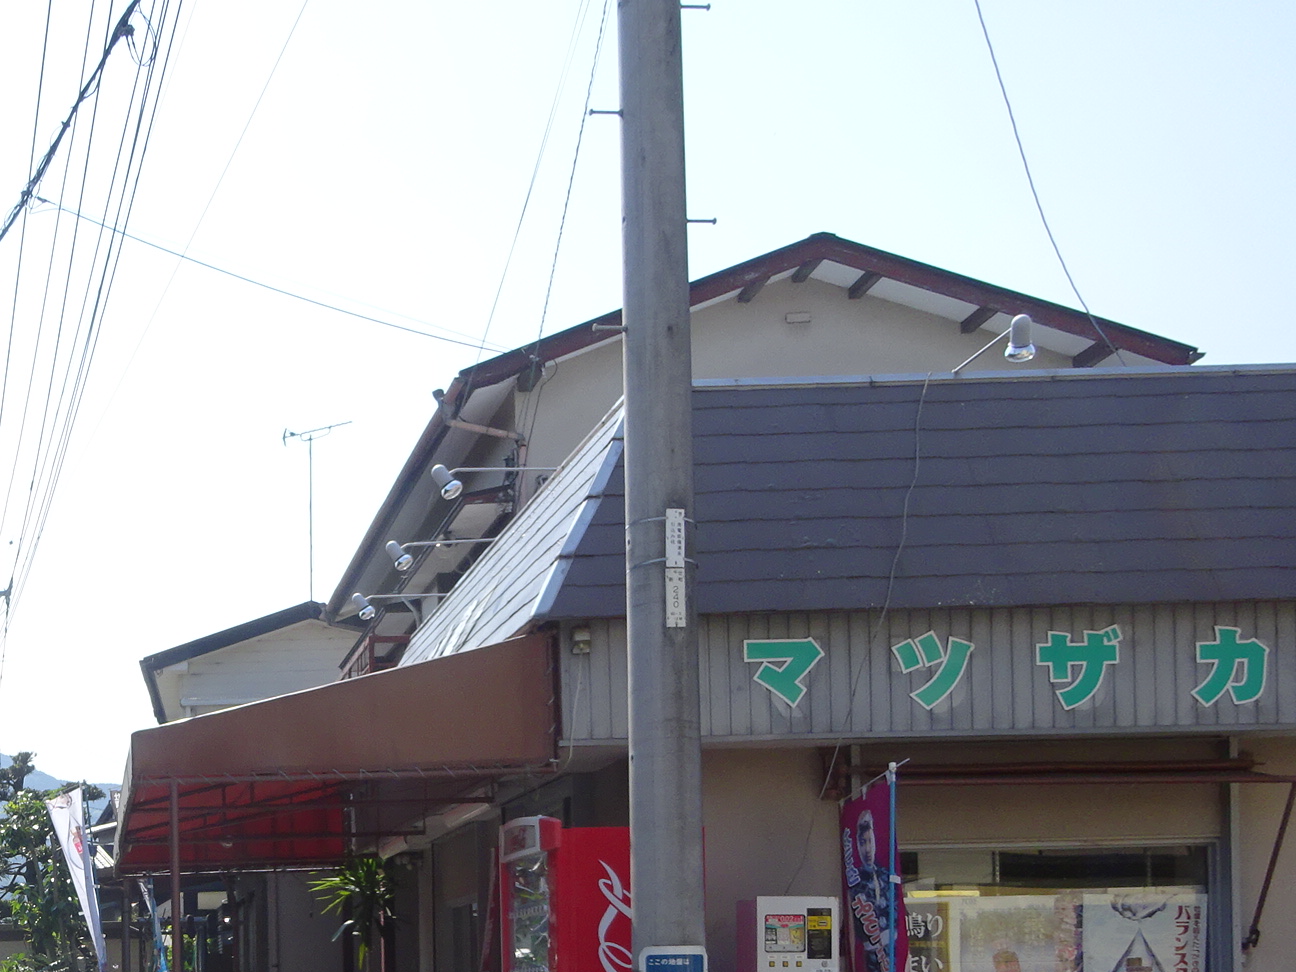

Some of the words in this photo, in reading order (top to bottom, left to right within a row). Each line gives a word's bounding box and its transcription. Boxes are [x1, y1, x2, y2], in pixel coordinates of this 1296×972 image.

[672, 585, 680, 609] 240
[742, 623, 1271, 712] マツザカ
